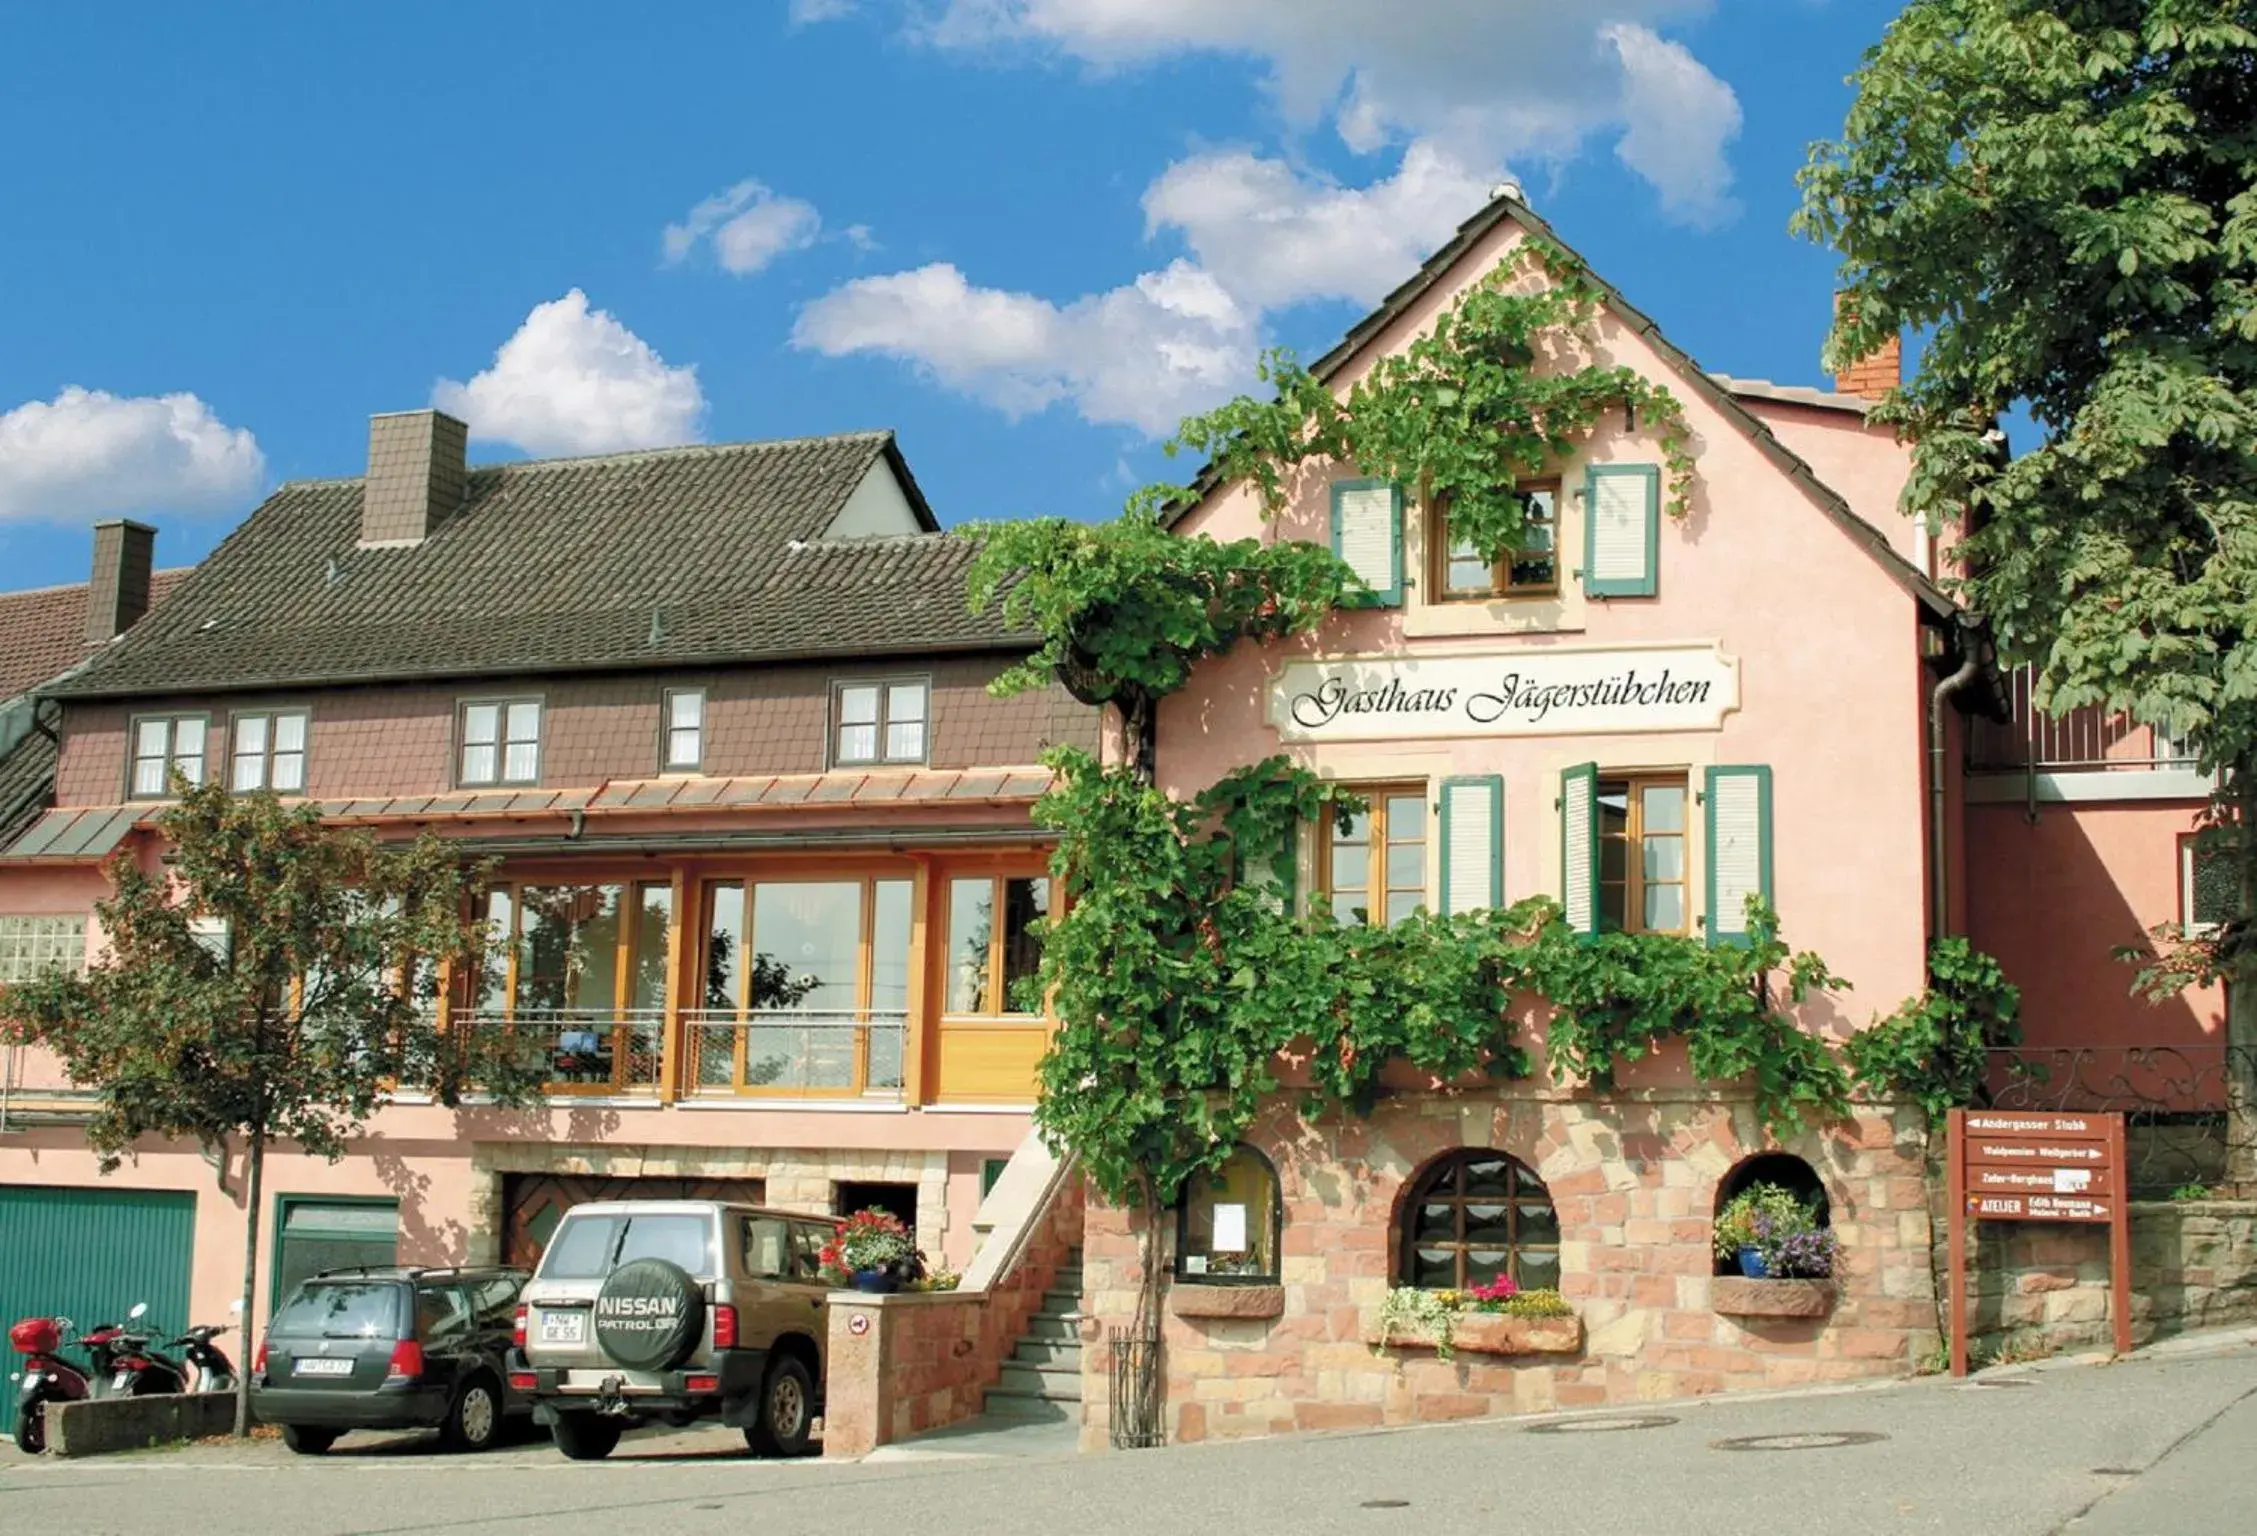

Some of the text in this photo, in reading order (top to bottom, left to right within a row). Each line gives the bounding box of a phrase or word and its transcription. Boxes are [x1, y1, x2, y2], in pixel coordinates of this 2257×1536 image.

[1290, 670, 1712, 727] Gasthaus Jägerstübchen
[1981, 1200, 2021, 1213] ATELIER
[599, 1297, 677, 1315] NISSAN
[599, 1320, 655, 1330] PATROL
